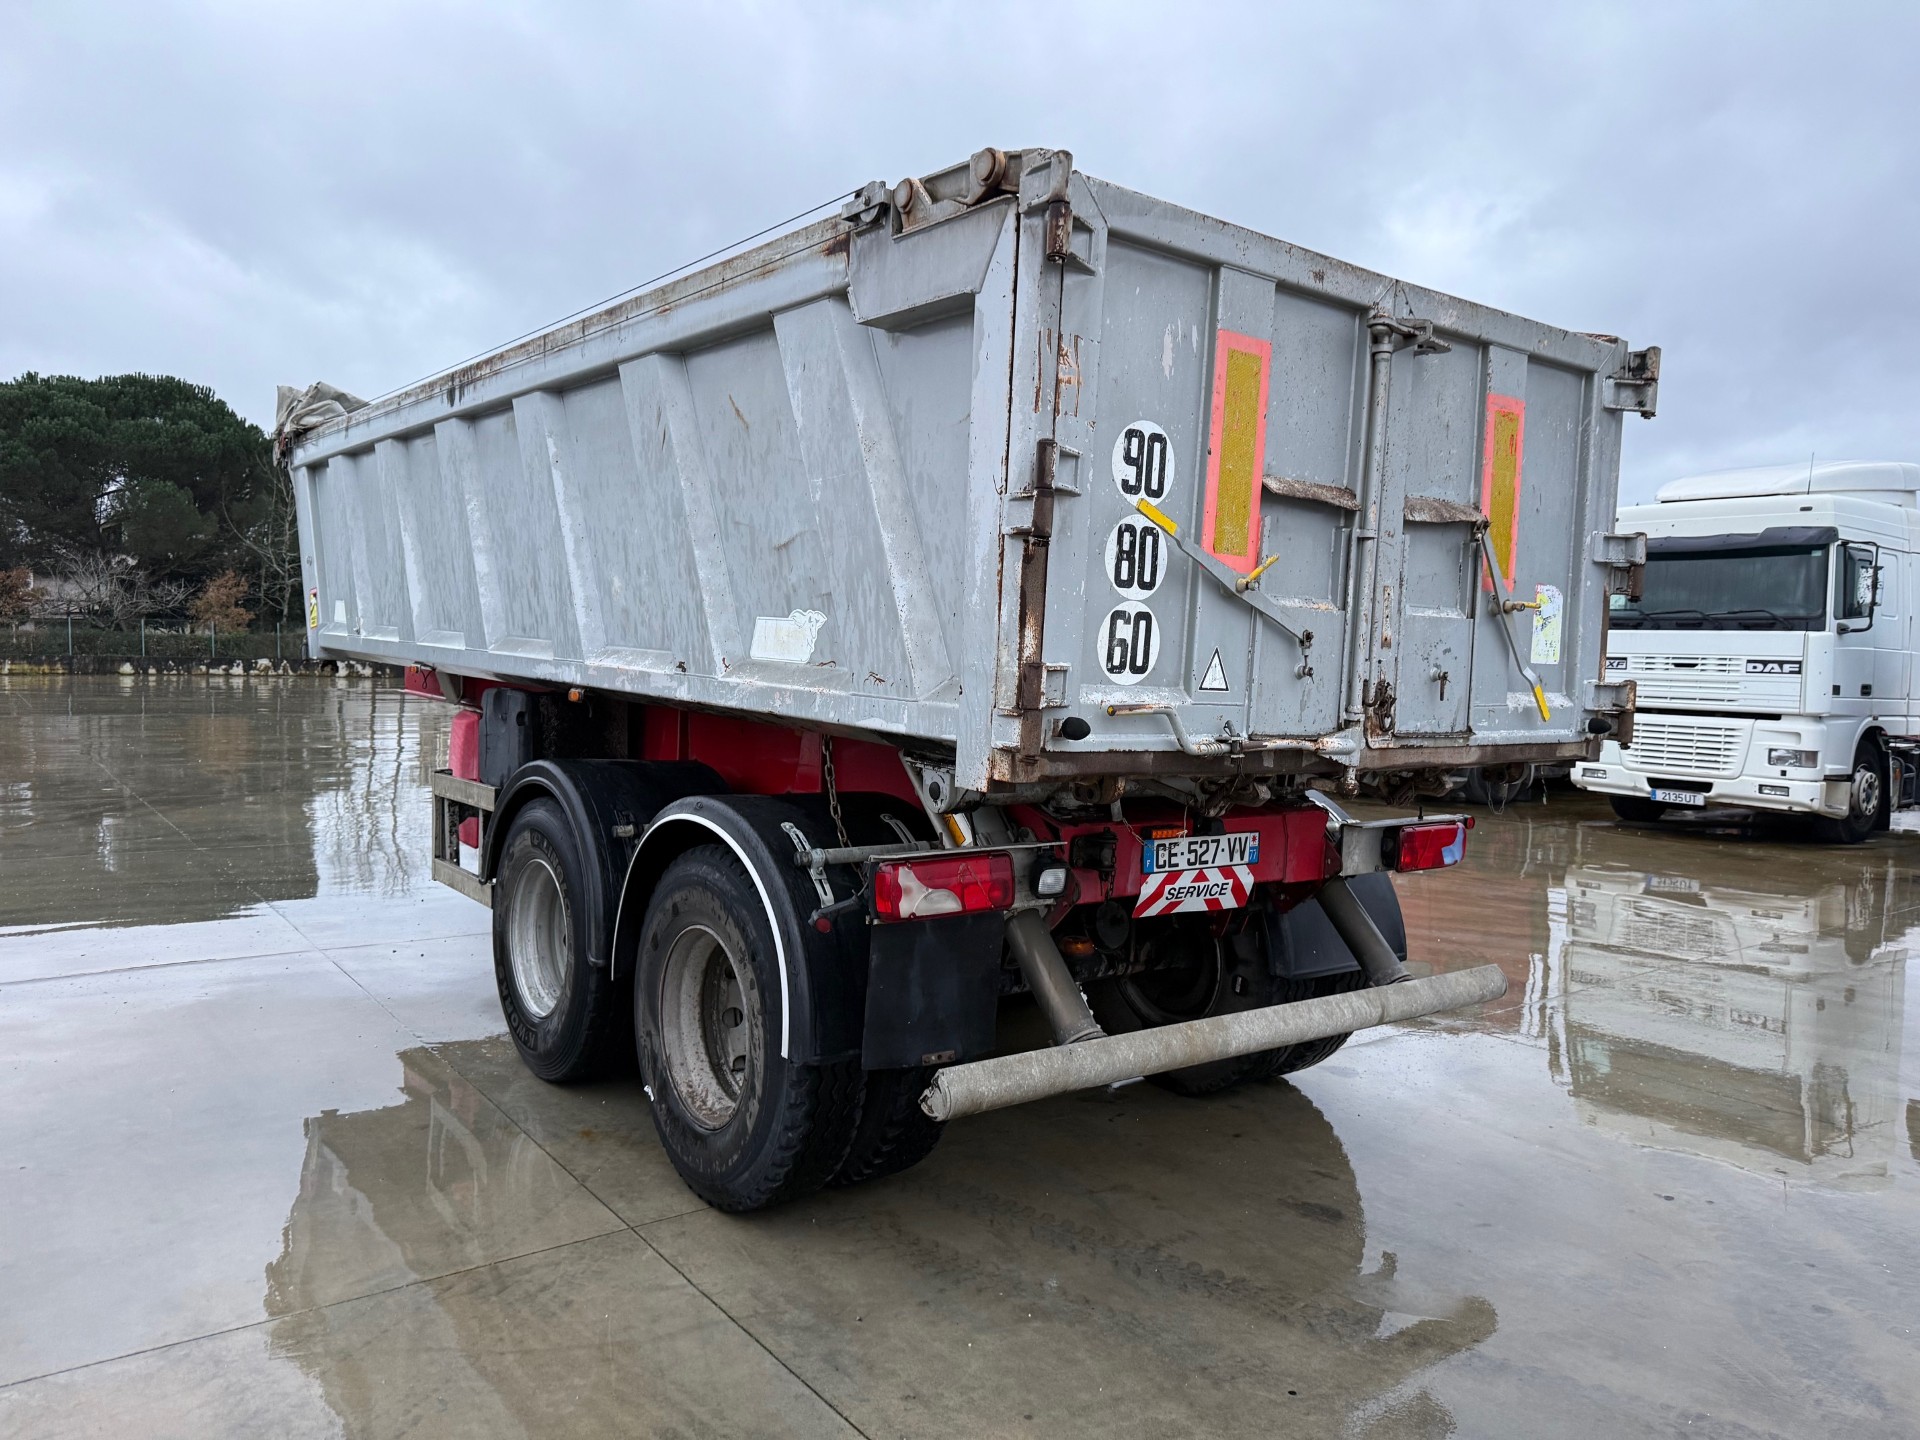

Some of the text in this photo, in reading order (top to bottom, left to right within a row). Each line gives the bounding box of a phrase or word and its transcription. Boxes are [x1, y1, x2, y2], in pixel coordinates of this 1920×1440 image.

[1121, 428, 1167, 498] 90
[1114, 523, 1160, 591] 80
[1106, 610, 1152, 674] 60
[1606, 660, 1626, 669] XF
[1746, 662, 1800, 673] DAF
[1146, 859, 1151, 869] F
[1249, 848, 1257, 860] 77
[1165, 882, 1230, 901] SERVICE
